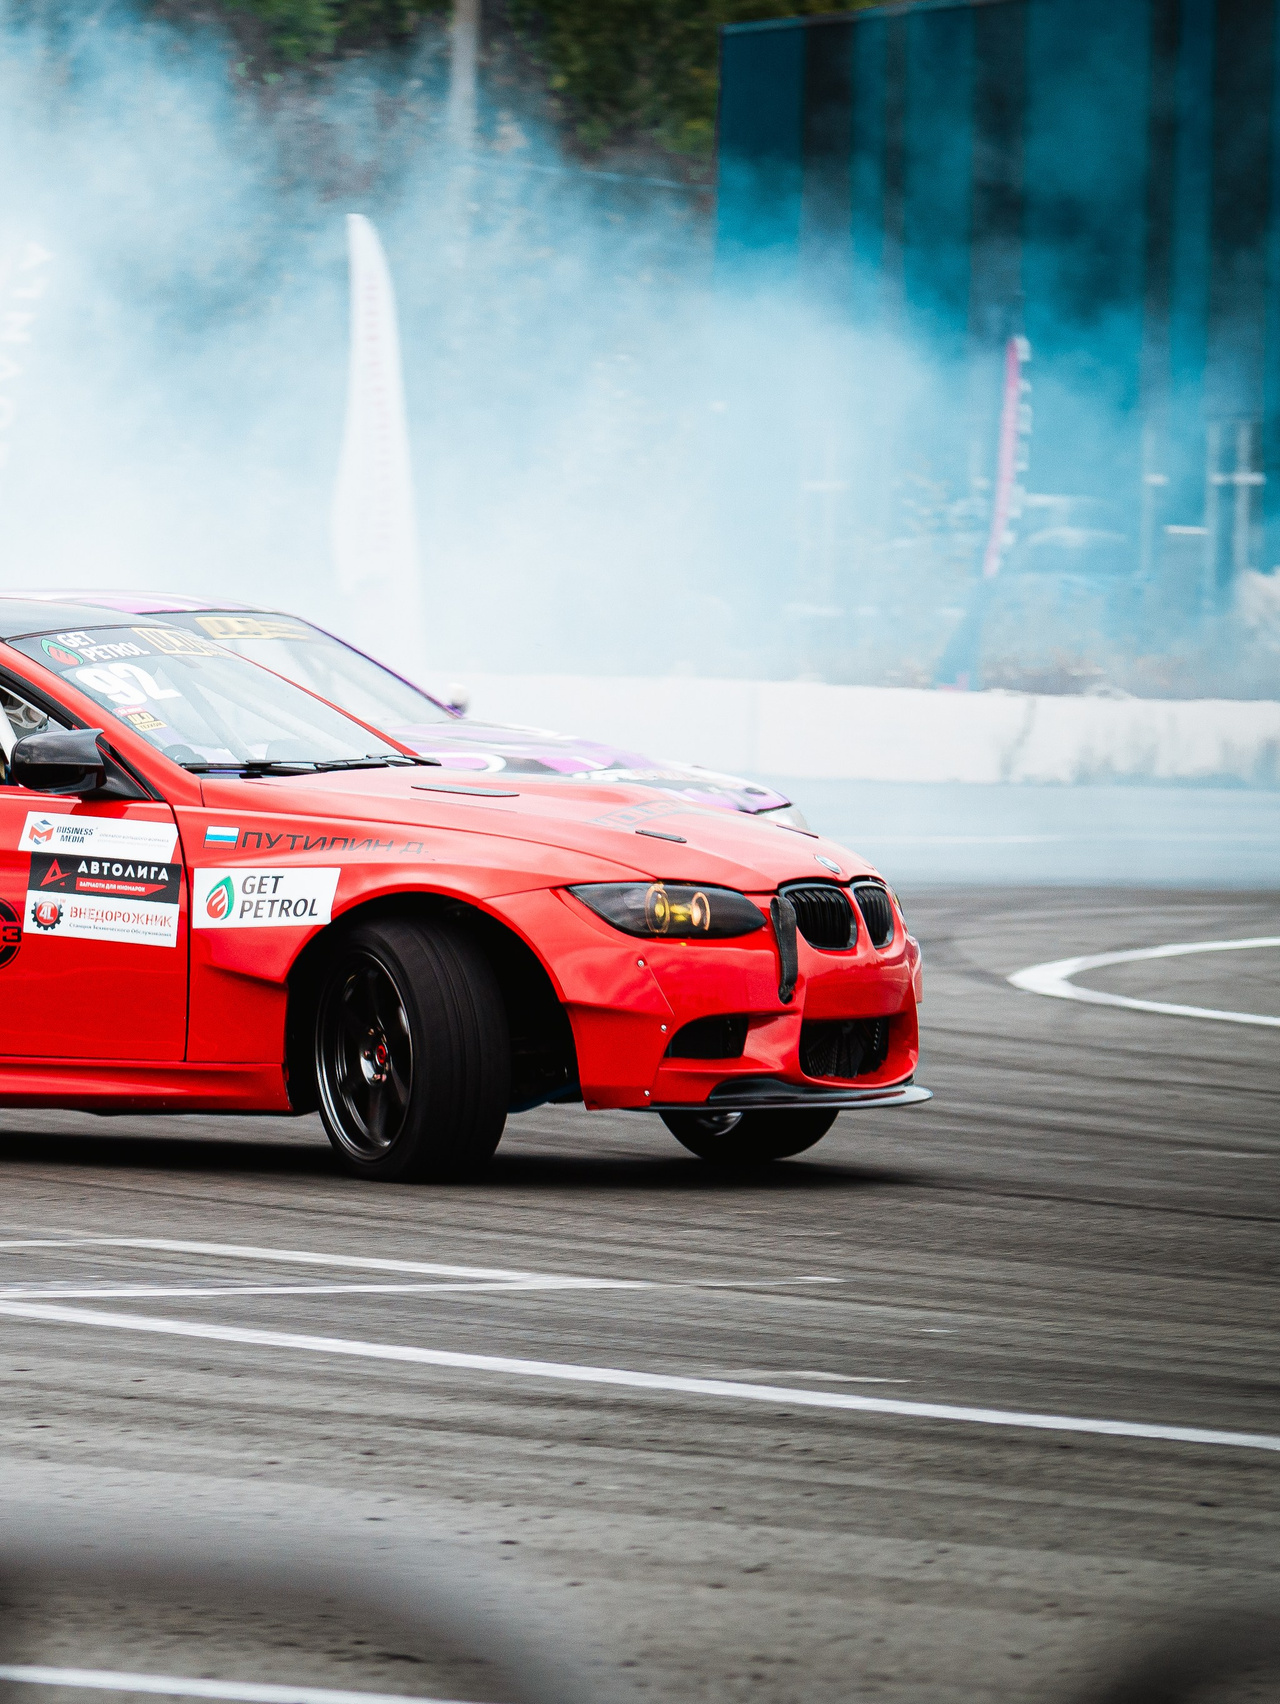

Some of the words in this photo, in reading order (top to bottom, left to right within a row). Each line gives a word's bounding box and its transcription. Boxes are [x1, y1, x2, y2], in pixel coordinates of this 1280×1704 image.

[56, 631, 97, 649] GET
[83, 641, 151, 662] PETROL
[75, 662, 183, 705] 92
[56, 826, 94, 836] BUSINESS
[59, 835, 85, 844] MEDIA
[241, 831, 394, 850] ПУТИЛИН
[76, 860, 169, 882] АВТОЛИГА
[241, 876, 284, 895] GET
[70, 906, 173, 928] ВНЕДОРОЖНИК
[239, 898, 318, 919] PETROL
